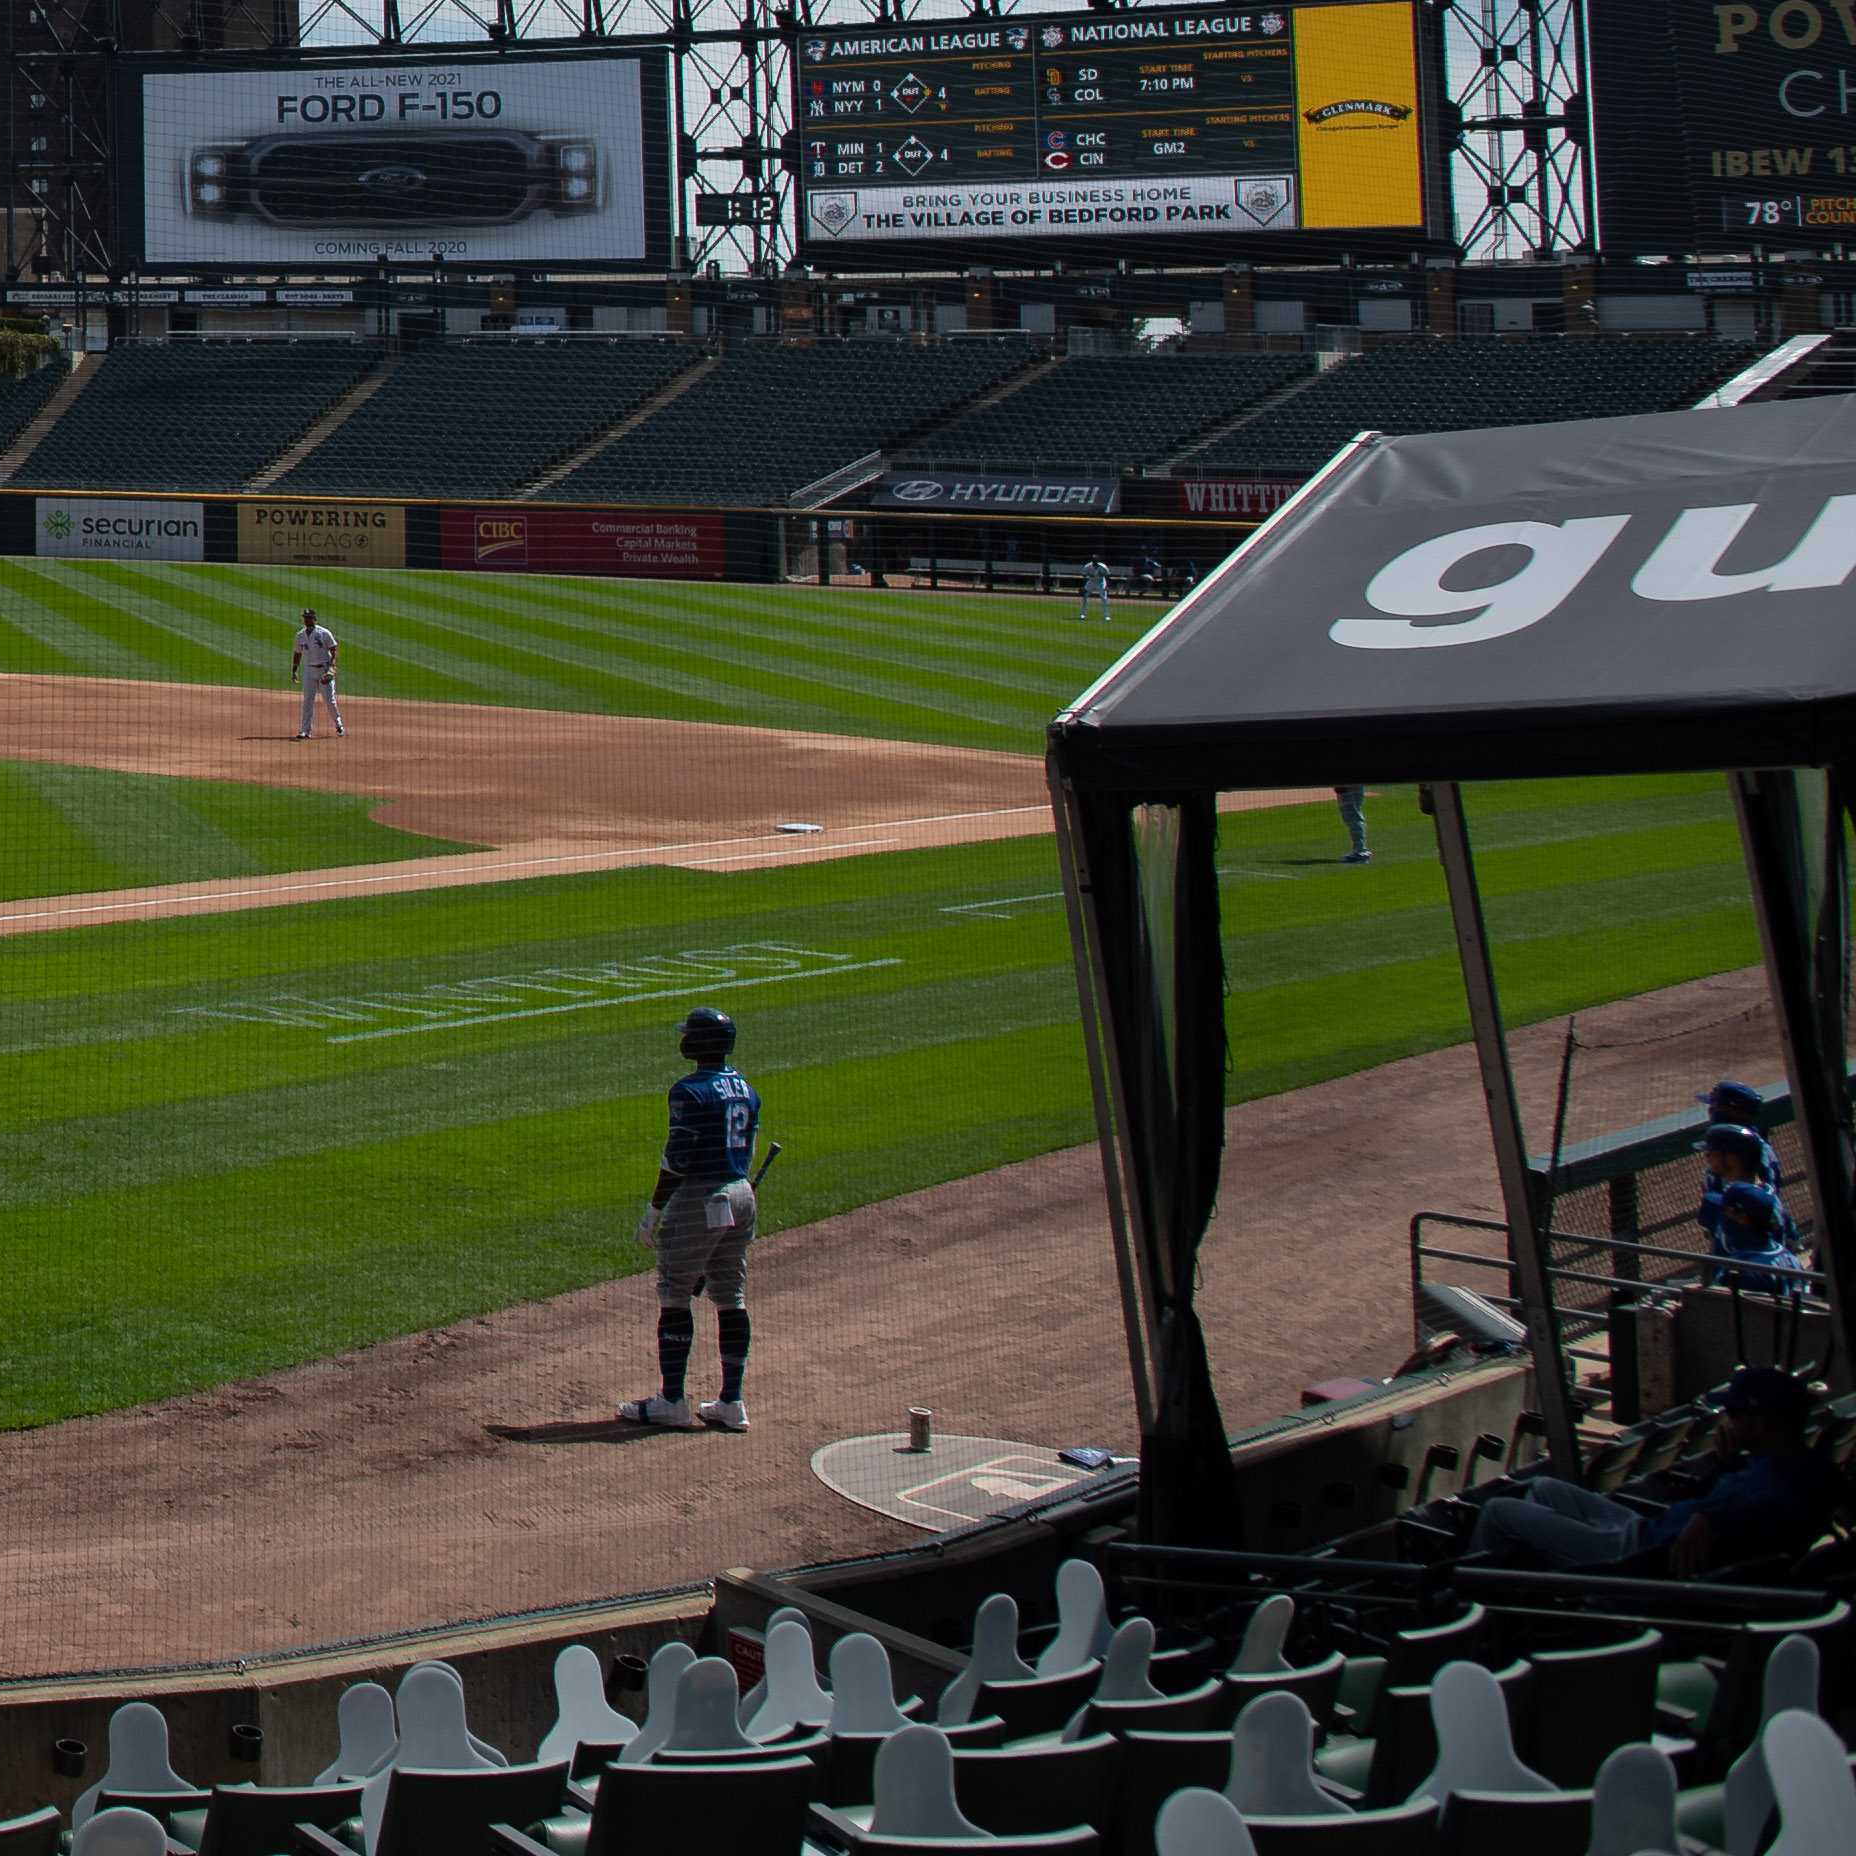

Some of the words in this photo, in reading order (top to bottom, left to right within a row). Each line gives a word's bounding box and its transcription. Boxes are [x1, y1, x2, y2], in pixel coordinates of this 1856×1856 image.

[1071, 22, 1169, 42] NATIONAL
[1174, 18, 1252, 37] LEAGUE
[830, 37, 923, 57] AMERICAN
[931, 33, 1000, 52] LEAGUE
[315, 77, 345, 88] THE
[350, 75, 423, 87] ALL-NEW
[428, 73, 461, 86] 2021
[277, 95, 385, 123] FORD
[398, 91, 501, 120] F-150
[903, 194, 962, 208] BRING
[969, 192, 1022, 206] YOUR
[1028, 190, 1124, 204] BUSINESS
[1132, 187, 1191, 202] HOME
[863, 213, 906, 229] THE
[912, 211, 1004, 227] VILLAGE
[1011, 209, 1041, 224] OF
[1049, 206, 1159, 222] BEDFORD
[1166, 203, 1231, 220] PARK
[315, 243, 379, 254] COMING
[385, 243, 423, 254] FALL
[428, 242, 467, 253] 2020
[950, 484, 1100, 504] HYUNDAI
[82, 515, 198, 537] securian
[256, 509, 386, 528] POWERING
[479, 521, 523, 539] CIBC
[591, 522, 651, 536] Commercial
[655, 523, 697, 537] Banking
[82, 537, 151, 549] FINANCIAL
[616, 537, 651, 552] Capital
[654, 537, 697, 551] Markets
[622, 552, 656, 565] Private
[661, 552, 698, 566] Wealth
[713, 1077, 750, 1100] SOLER
[727, 1103, 749, 1147] 12
